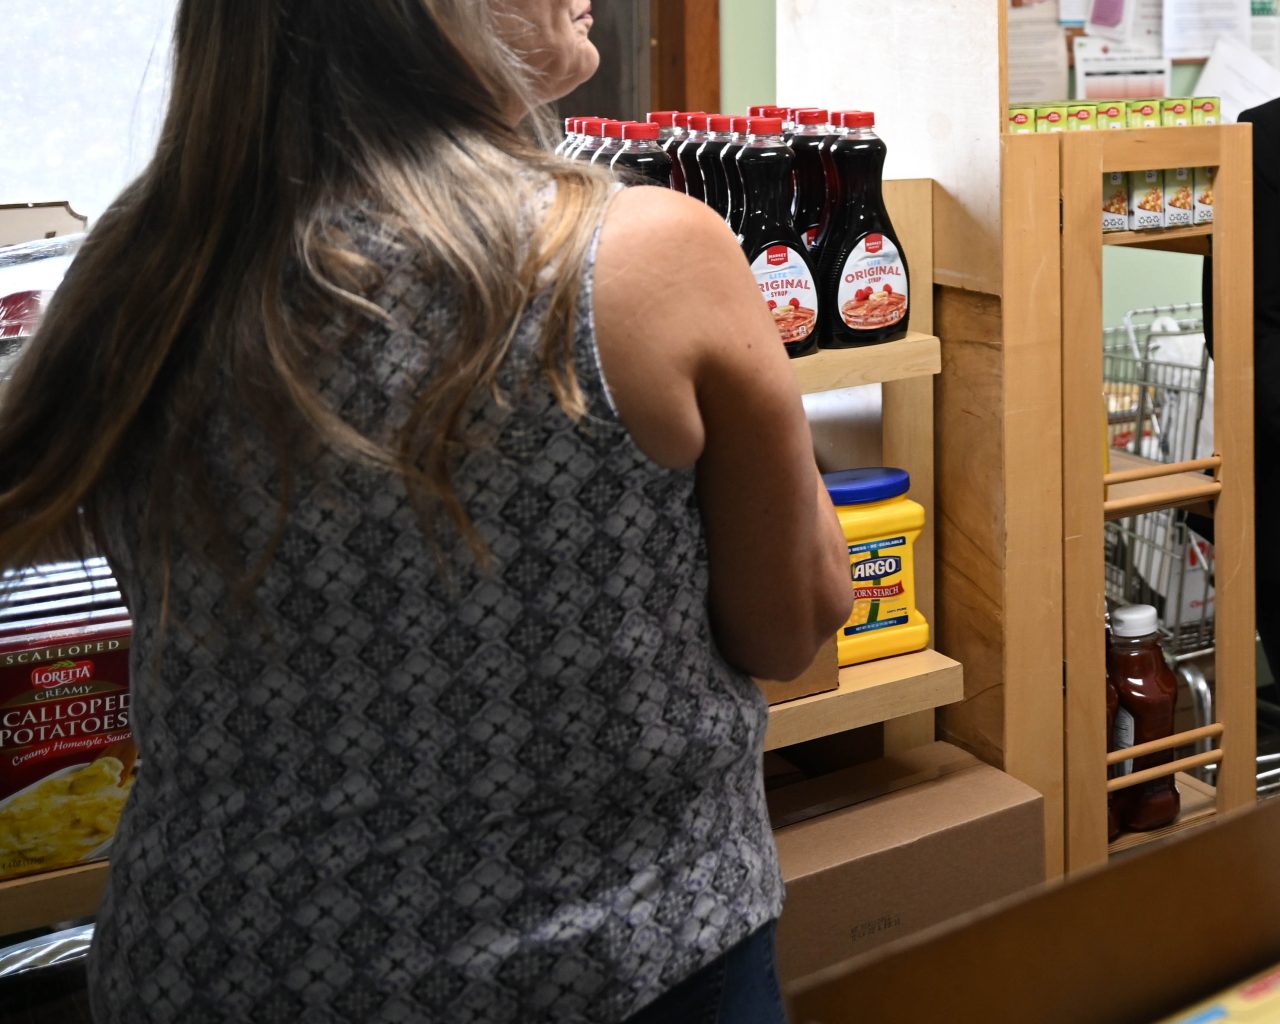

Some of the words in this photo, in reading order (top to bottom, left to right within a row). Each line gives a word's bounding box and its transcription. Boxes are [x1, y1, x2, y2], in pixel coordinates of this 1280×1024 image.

[844, 266, 902, 284] ORIGINAL
[758, 279, 811, 292] RIGINAL
[770, 290, 788, 298] SYRUP
[853, 558, 896, 579] ARGO
[853, 589, 872, 598] CORN
[873, 586, 899, 597] STARCH
[6, 640, 120, 665] SCALLOPED
[35, 665, 91, 685] LORETTA
[34, 685, 93, 701] CREAMY
[2, 693, 131, 728] CALLOPED
[0, 711, 129, 747] POTATOES
[12, 746, 51, 767] Creamy
[53, 736, 102, 751] Homestyle
[104, 731, 132, 744] Sauce
